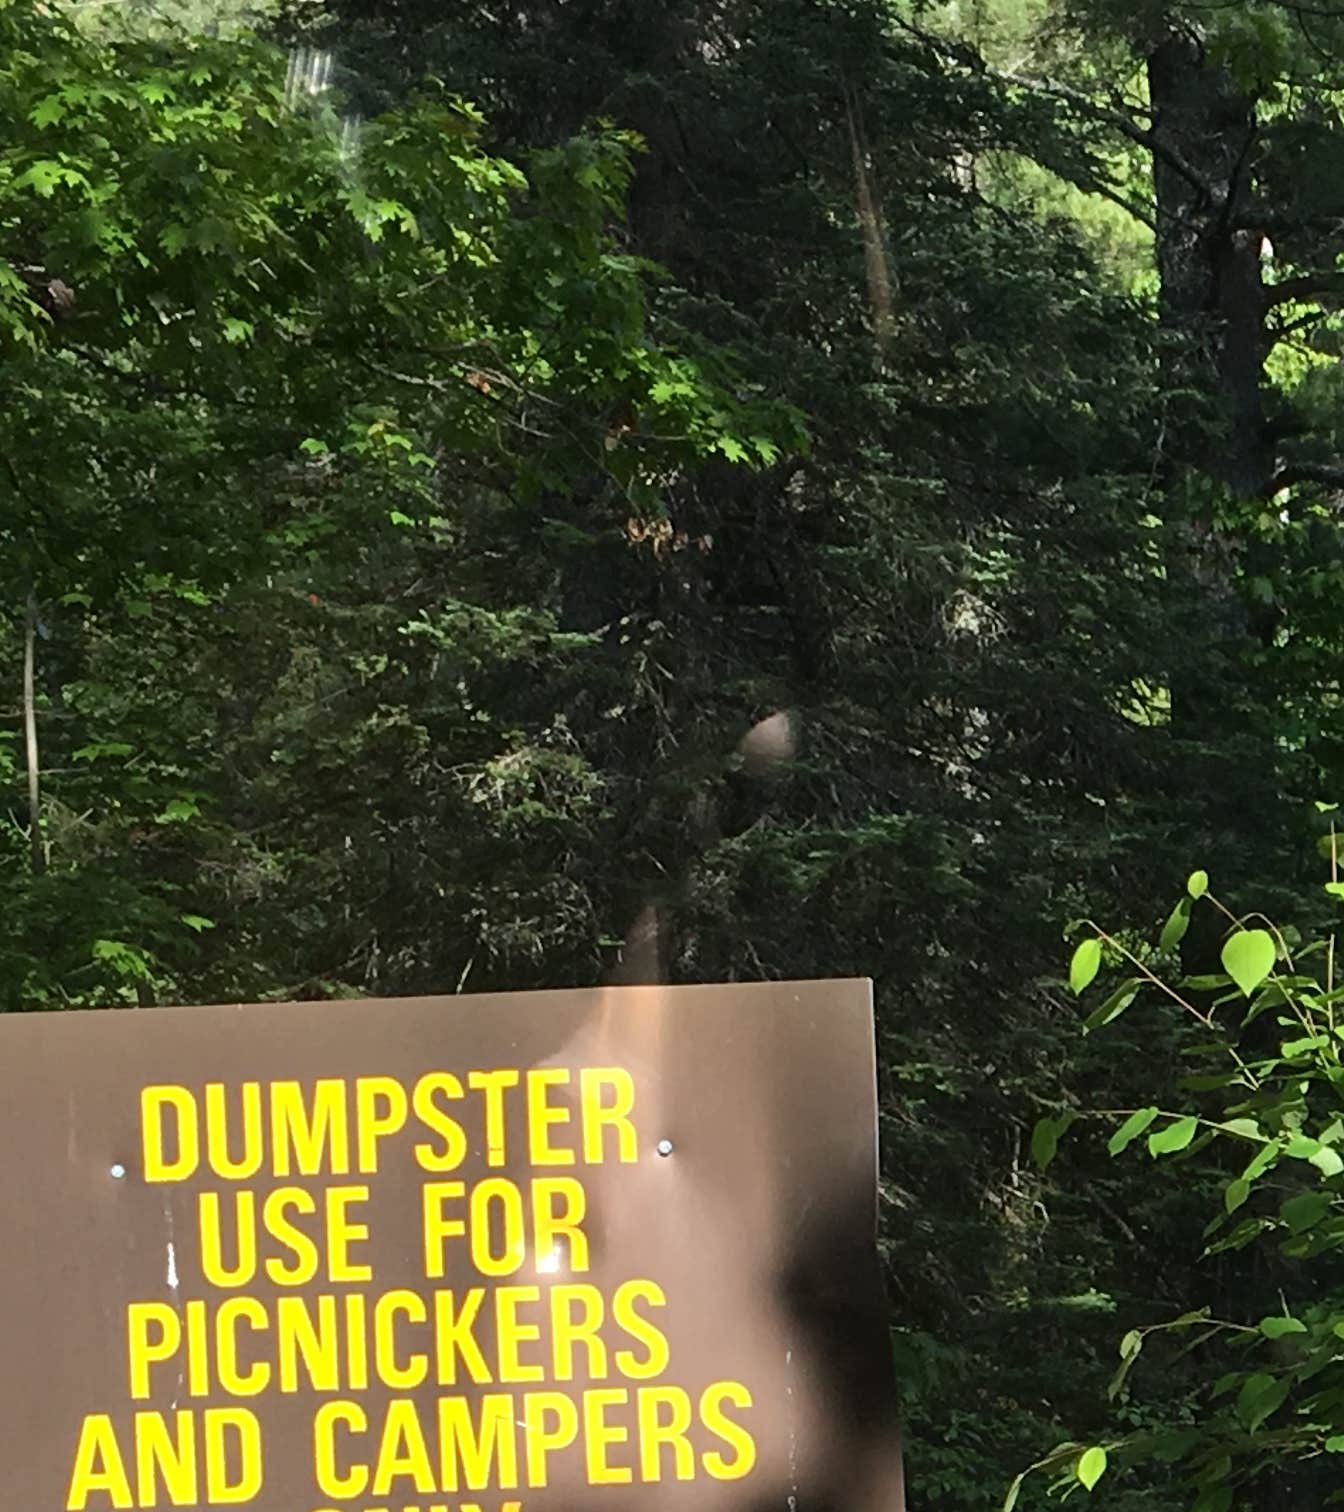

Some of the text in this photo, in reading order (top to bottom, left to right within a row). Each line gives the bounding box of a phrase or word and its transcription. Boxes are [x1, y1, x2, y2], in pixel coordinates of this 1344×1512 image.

[141, 1066, 639, 1184] DUMPSTER
[199, 1176, 589, 1288] USE FOR
[127, 1279, 670, 1400] PICNICKERS
[66, 1381, 757, 1512] AND CAMPERS
